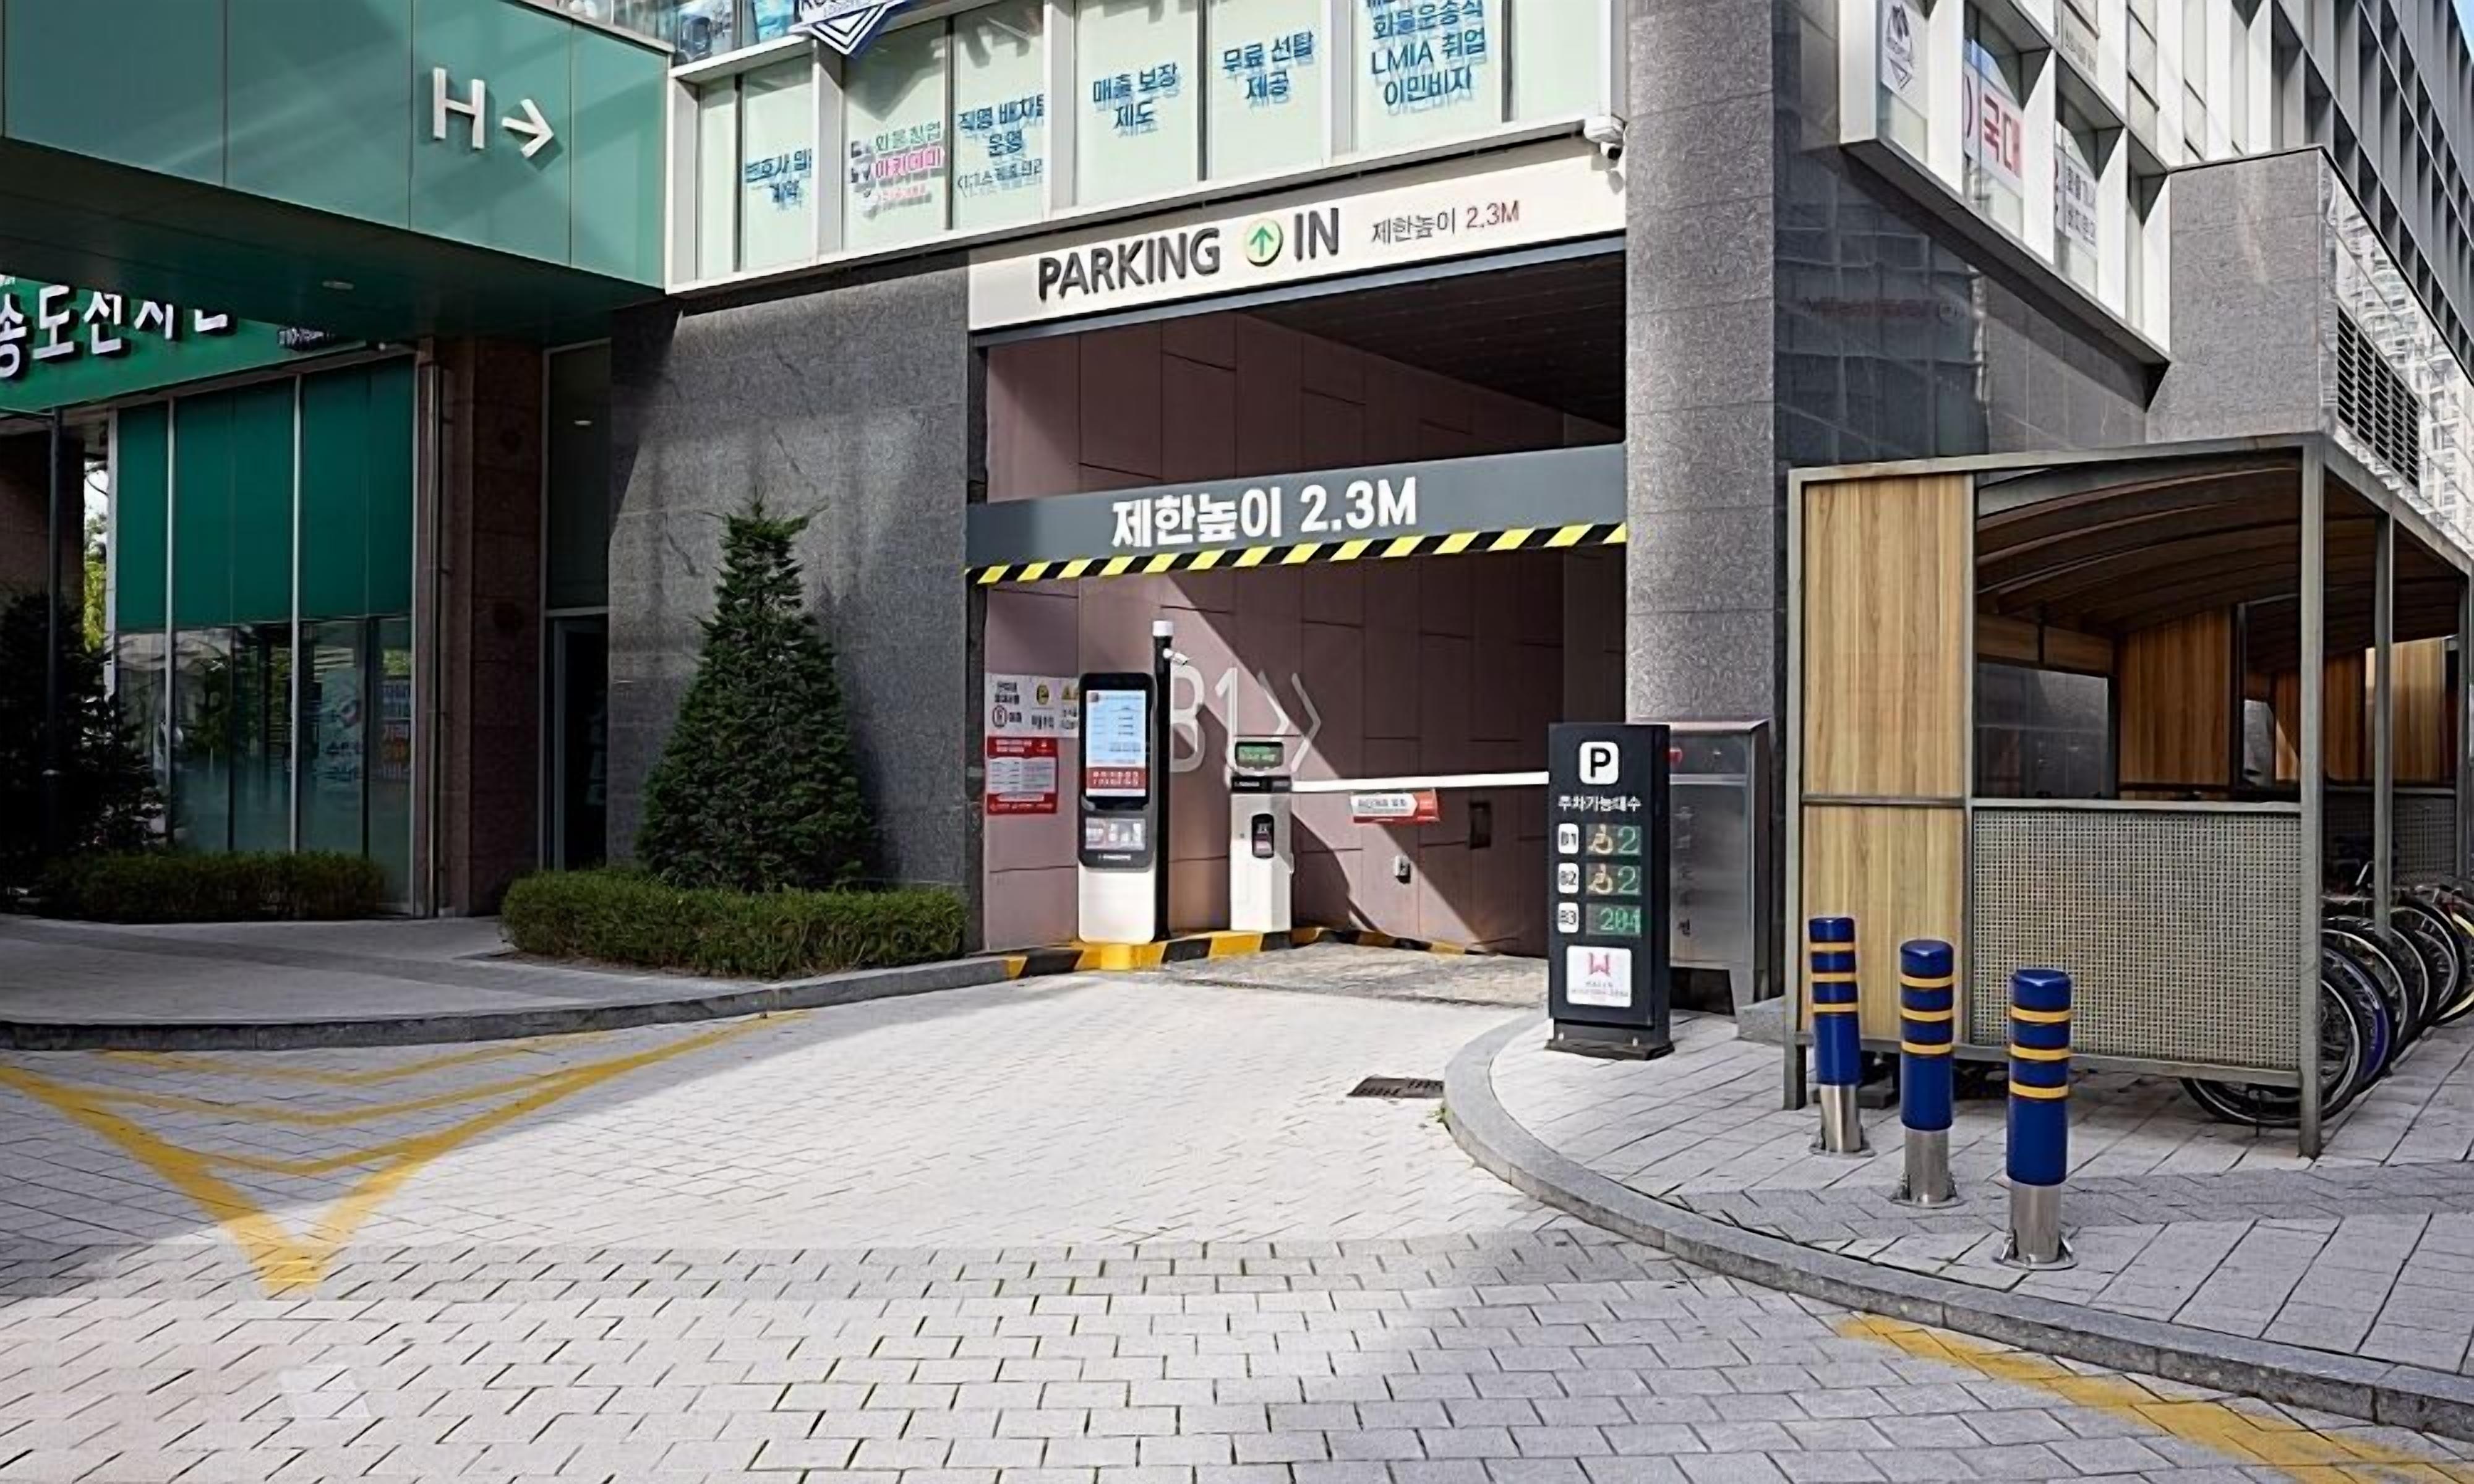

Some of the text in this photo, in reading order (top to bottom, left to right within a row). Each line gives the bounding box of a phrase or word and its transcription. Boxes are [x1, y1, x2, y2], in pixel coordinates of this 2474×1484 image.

[1371, 40, 1434, 74] LMIA
[1384, 65, 1472, 106] 이민비자
[434, 67, 485, 149] H
[1038, 200, 1520, 302] PARKING IN 제한높이 2.3M
[1111, 475, 1418, 548] 제한높이 2.3M
[1590, 747, 1611, 777] P
[1618, 826, 1640, 854] 2
[1617, 866, 1638, 893] 2
